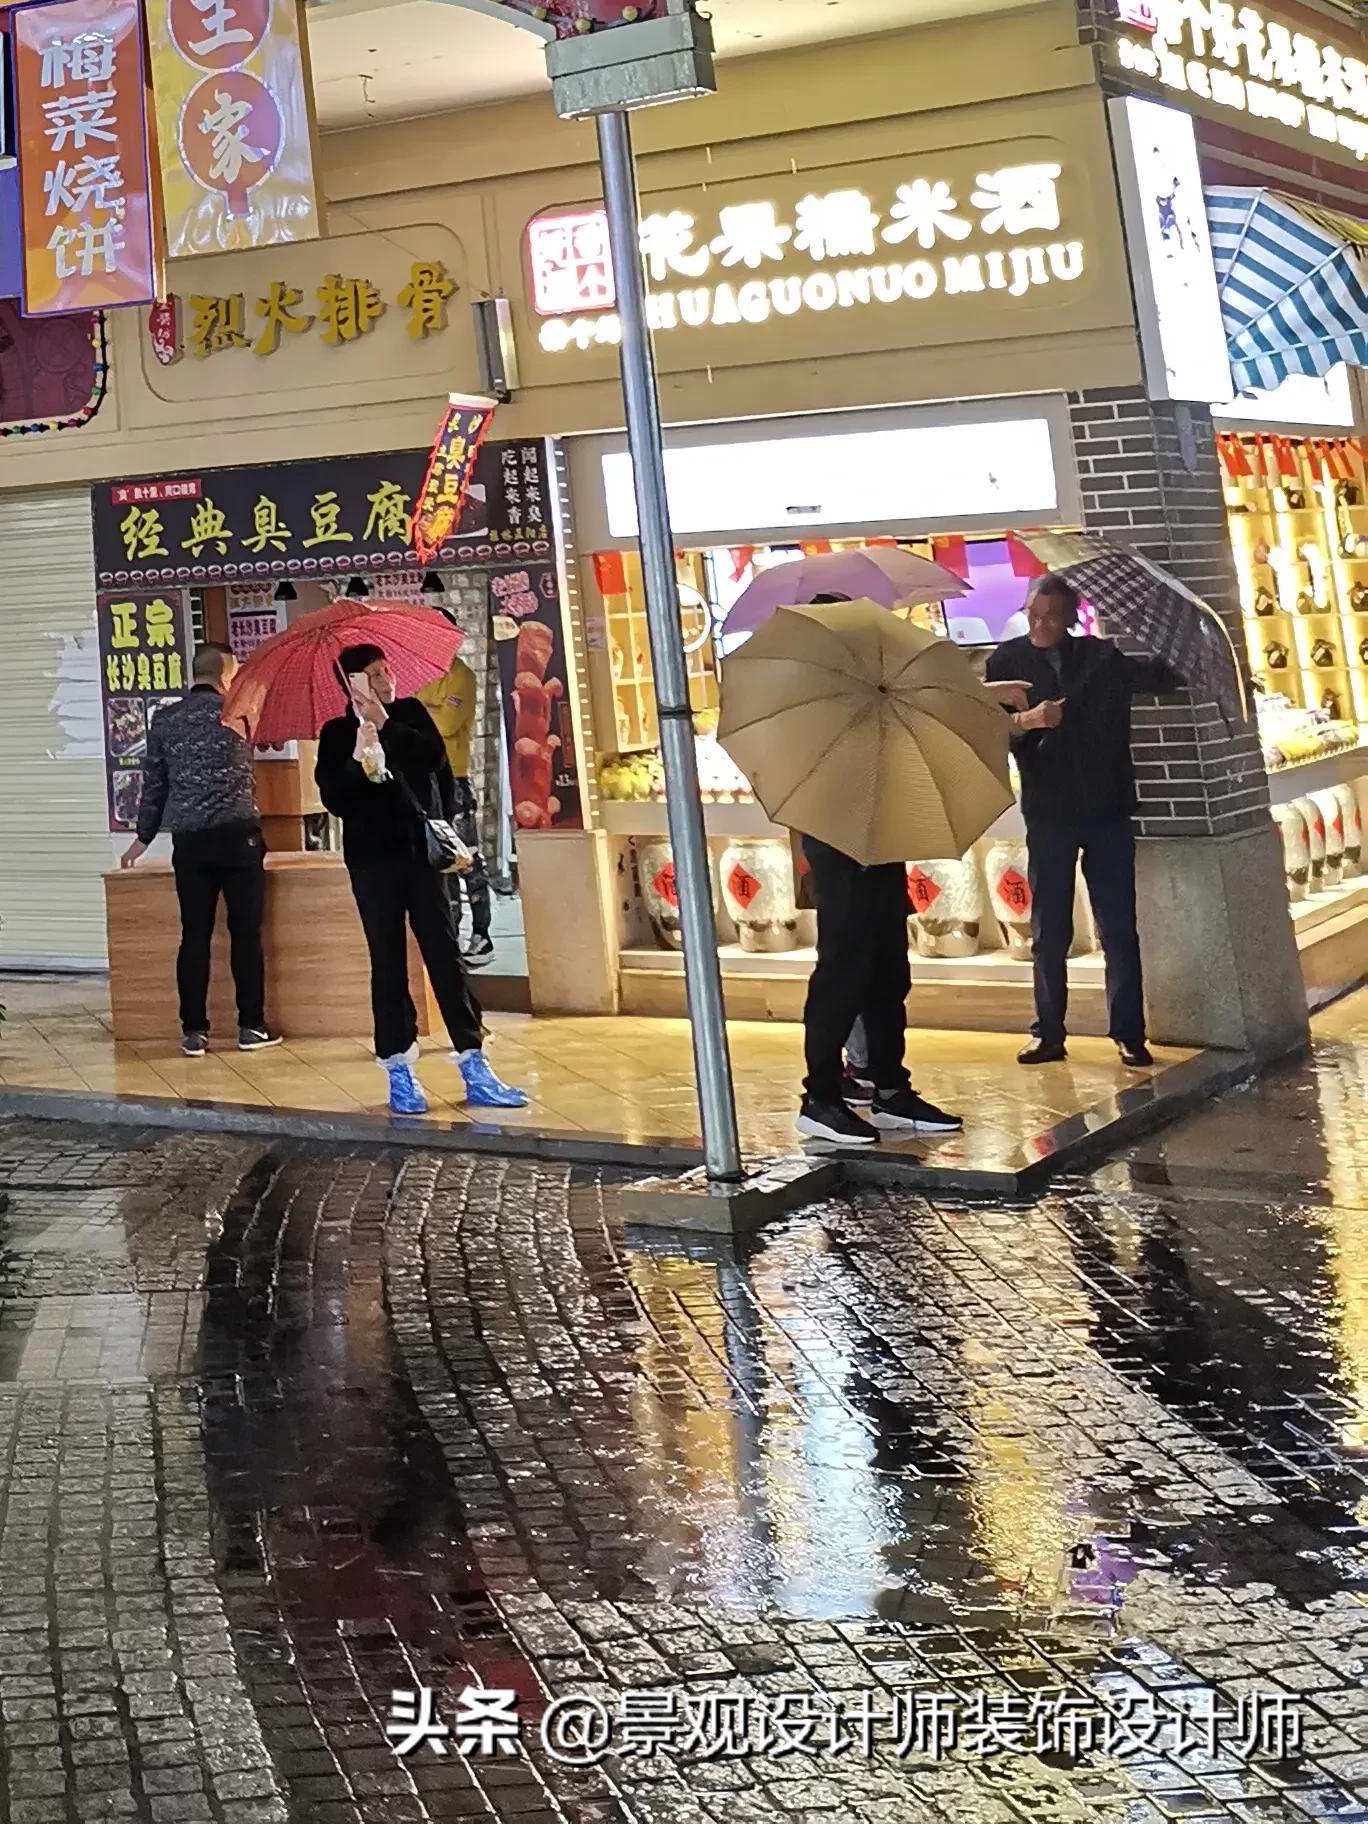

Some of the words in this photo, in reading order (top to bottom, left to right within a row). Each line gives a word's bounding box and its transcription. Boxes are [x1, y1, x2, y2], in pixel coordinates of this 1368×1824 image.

[41, 32, 127, 278] 梅菜烧饼
[639, 163, 1062, 280] 花果糯米酒
[188, 261, 460, 358] 烈火排骨
[644, 260, 935, 330] HUAGUONUO
[945, 241, 1084, 296] MIJIU
[120, 480, 412, 561] 经典臭豆腐
[110, 598, 175, 648] 正宗
[107, 652, 182, 691] 长沙臭豆腐
